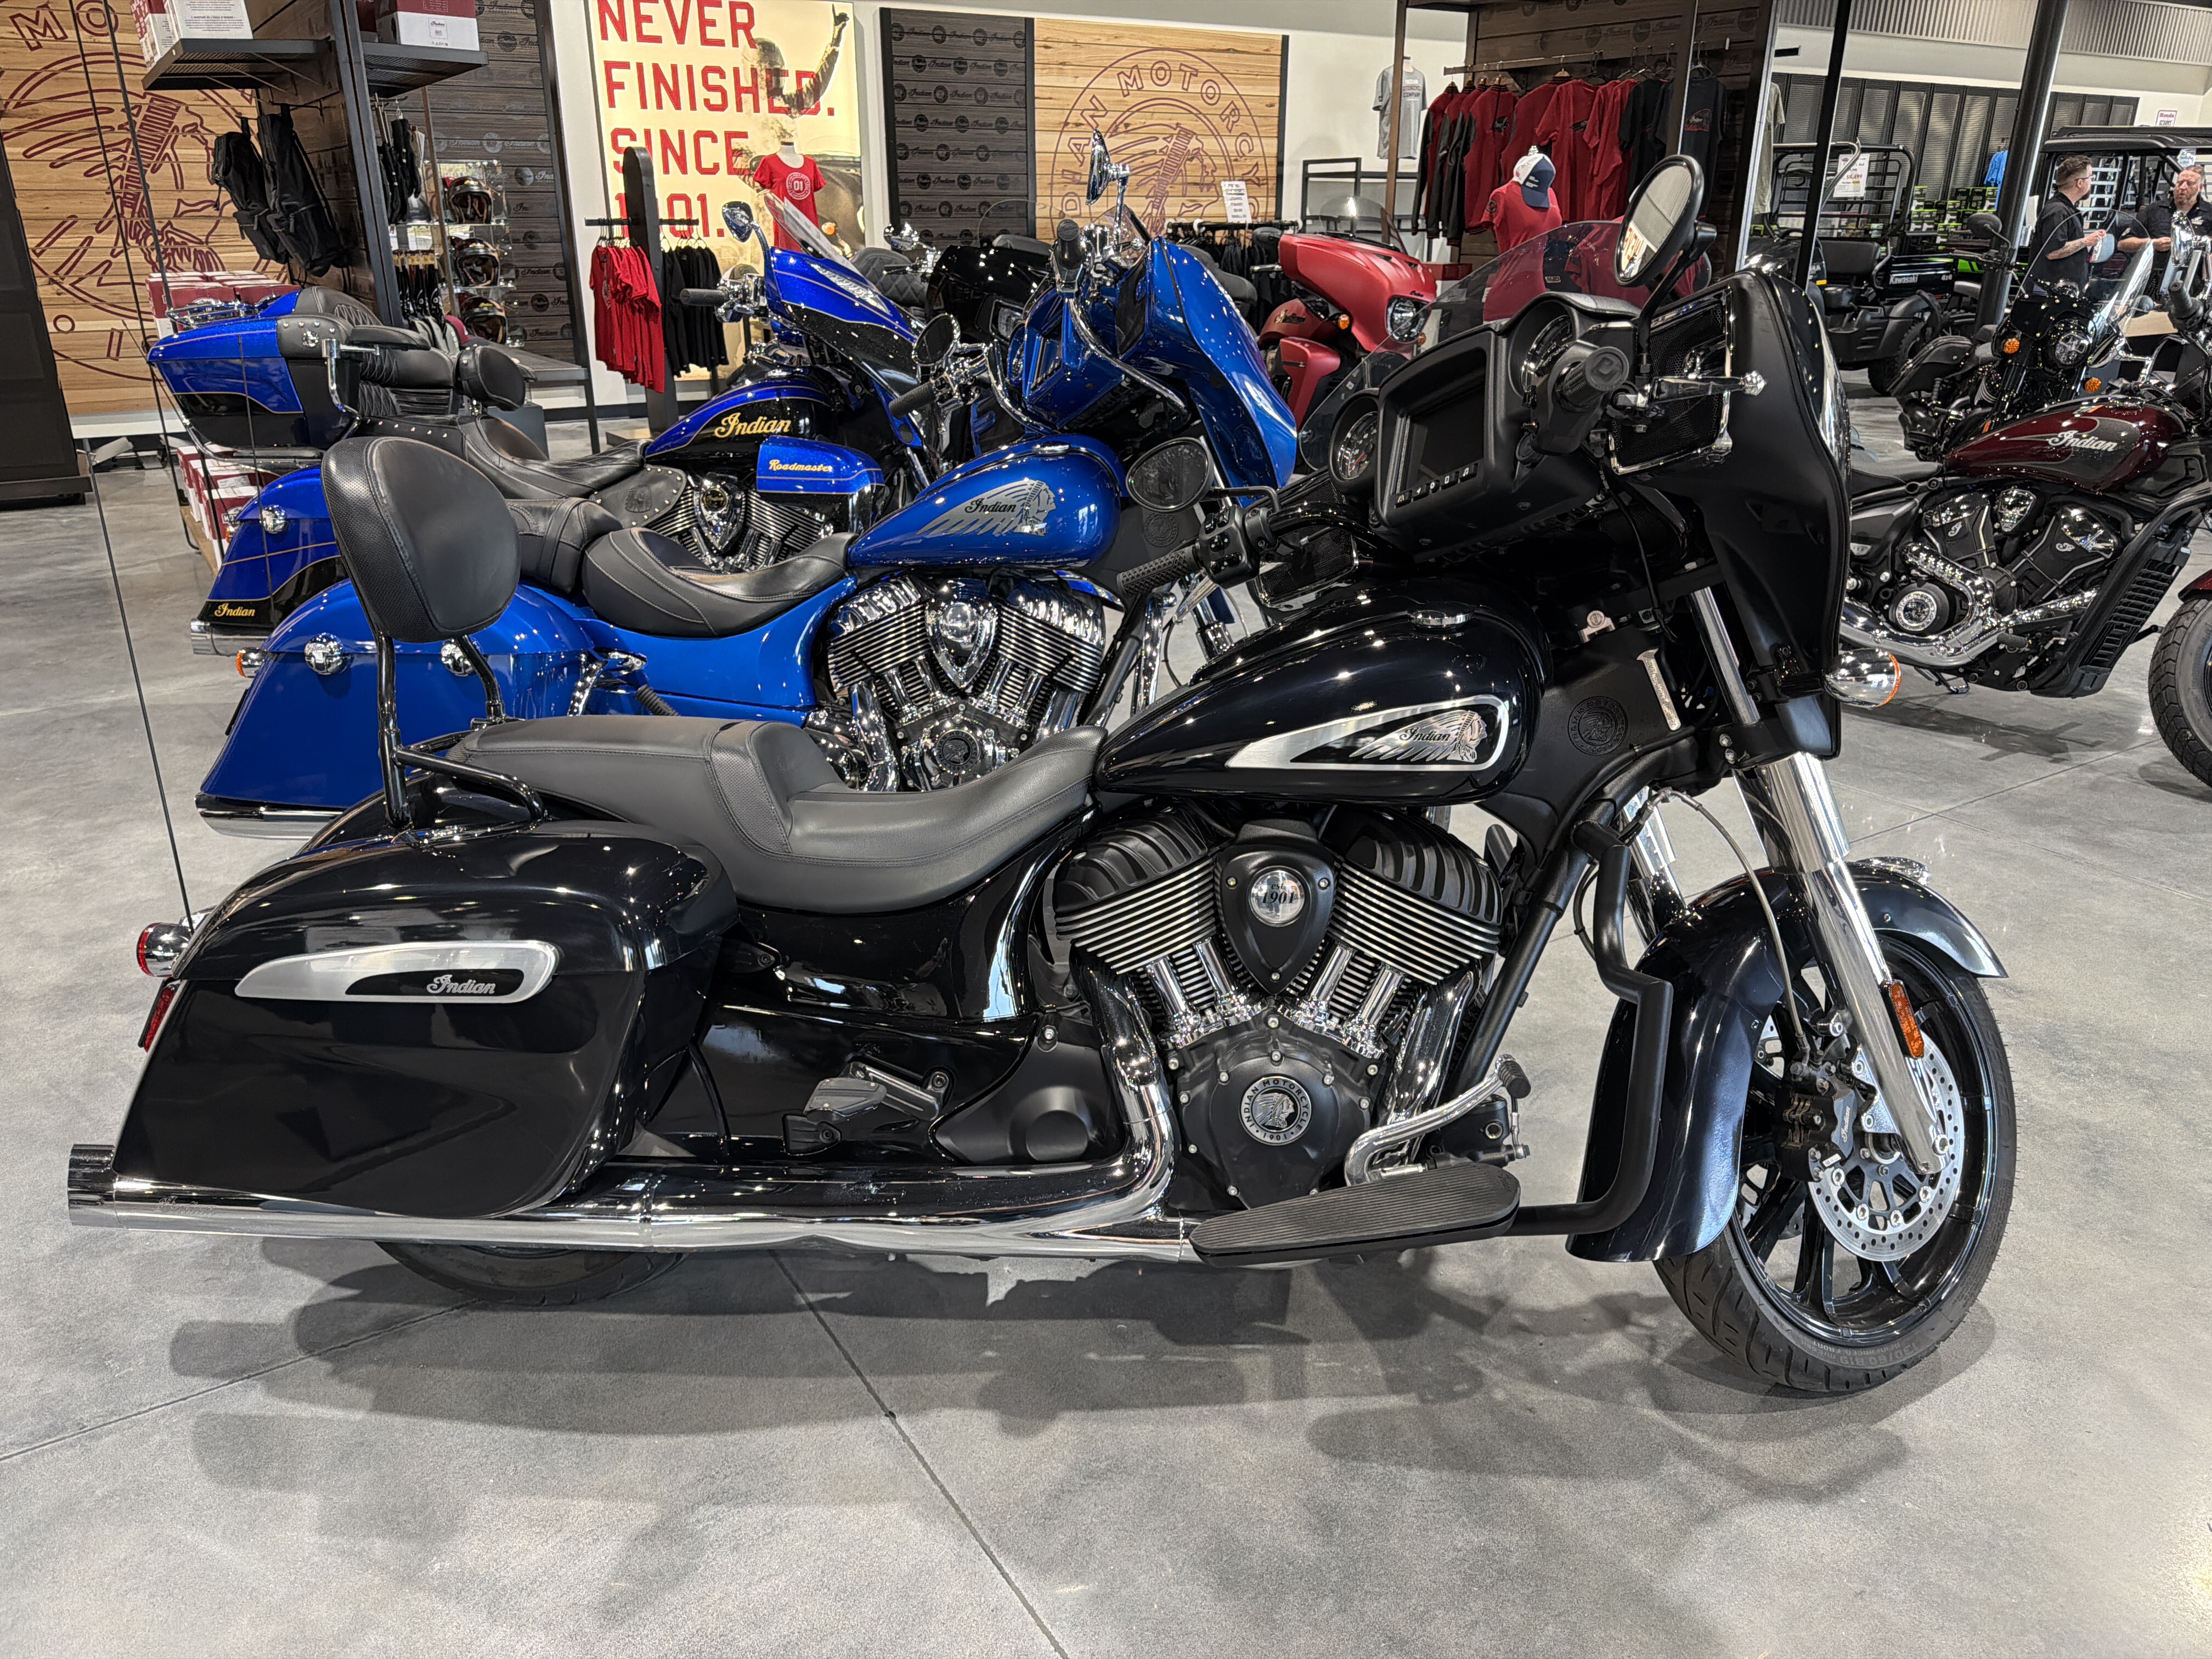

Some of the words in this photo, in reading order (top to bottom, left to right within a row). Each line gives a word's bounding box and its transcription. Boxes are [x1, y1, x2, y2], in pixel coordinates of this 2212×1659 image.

[597, 0, 759, 49] NEVER
[603, 60, 834, 116] FINISHED.
[793, 180, 803, 191] 01
[614, 193, 725, 238] 101.
[1889, 274, 1918, 285] Kawasaki
[714, 412, 792, 439] Indian
[2048, 430, 2118, 452] Indian
[768, 458, 833, 473] Roadmaster
[964, 497, 1017, 515] Indian
[214, 603, 256, 617] Indian
[1399, 726, 1452, 744] Indian
[1262, 890, 1295, 904] 1901
[426, 974, 496, 994] Indian
[1244, 1086, 1259, 1128] INDIAN
[1262, 1079, 1309, 1131] MOTORCYCLE
[1841, 1105, 1850, 1143] Indian
[1263, 1132, 1287, 1141] 1901
